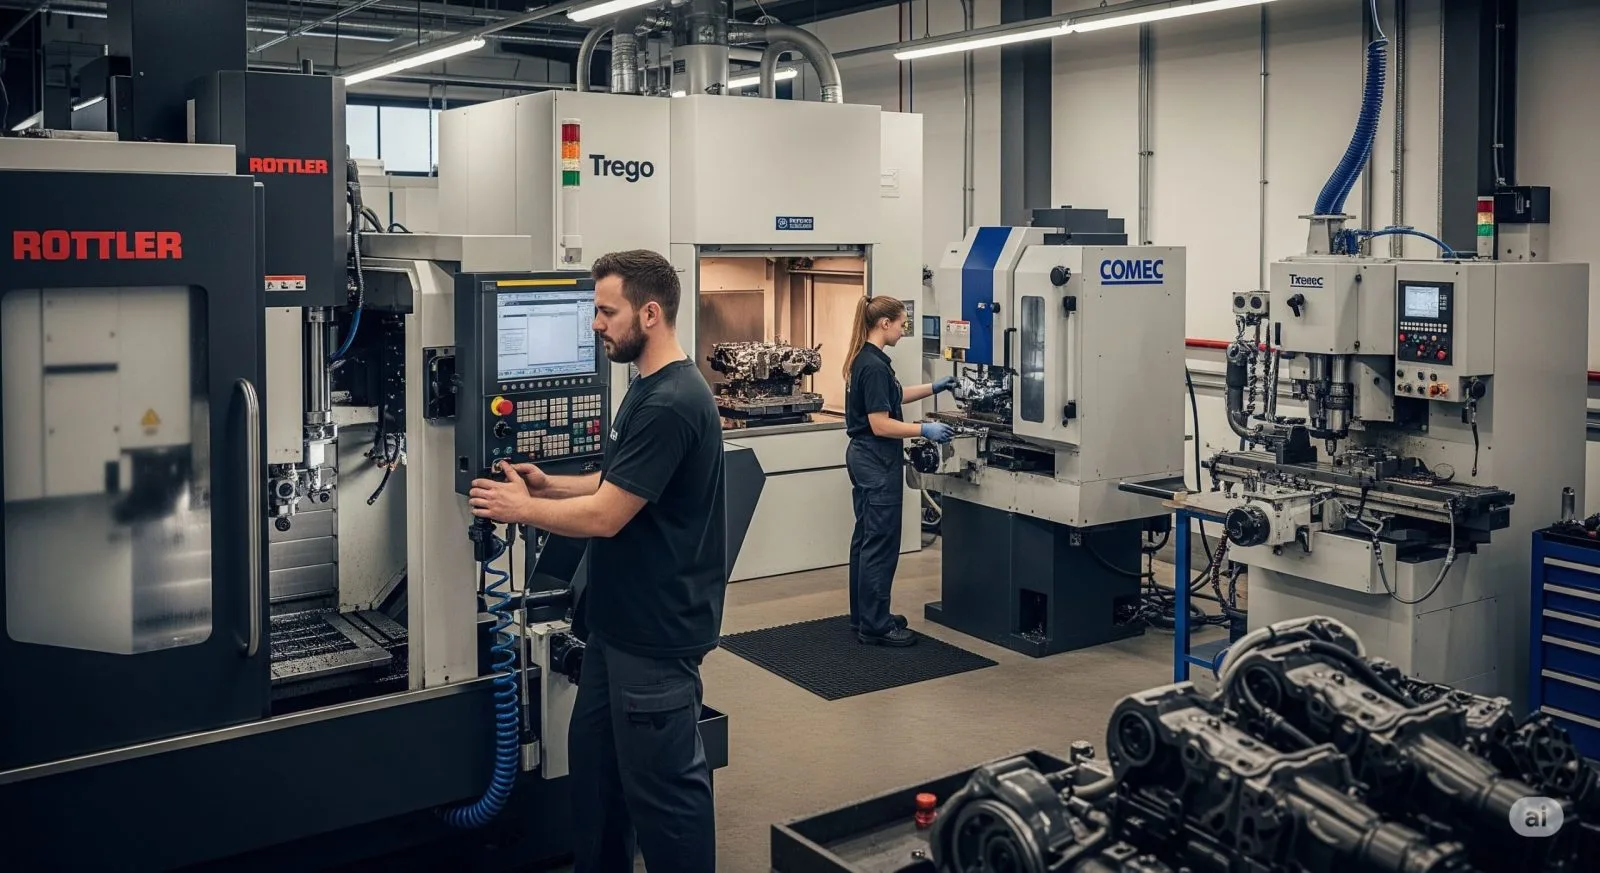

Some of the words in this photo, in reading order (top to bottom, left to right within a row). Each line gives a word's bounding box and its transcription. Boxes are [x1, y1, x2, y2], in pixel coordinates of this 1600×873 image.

[249, 157, 328, 174] ROTTLER
[589, 154, 654, 182] Trego
[14, 230, 182, 260] ROTTLER
[1100, 259, 1163, 280] COMEC
